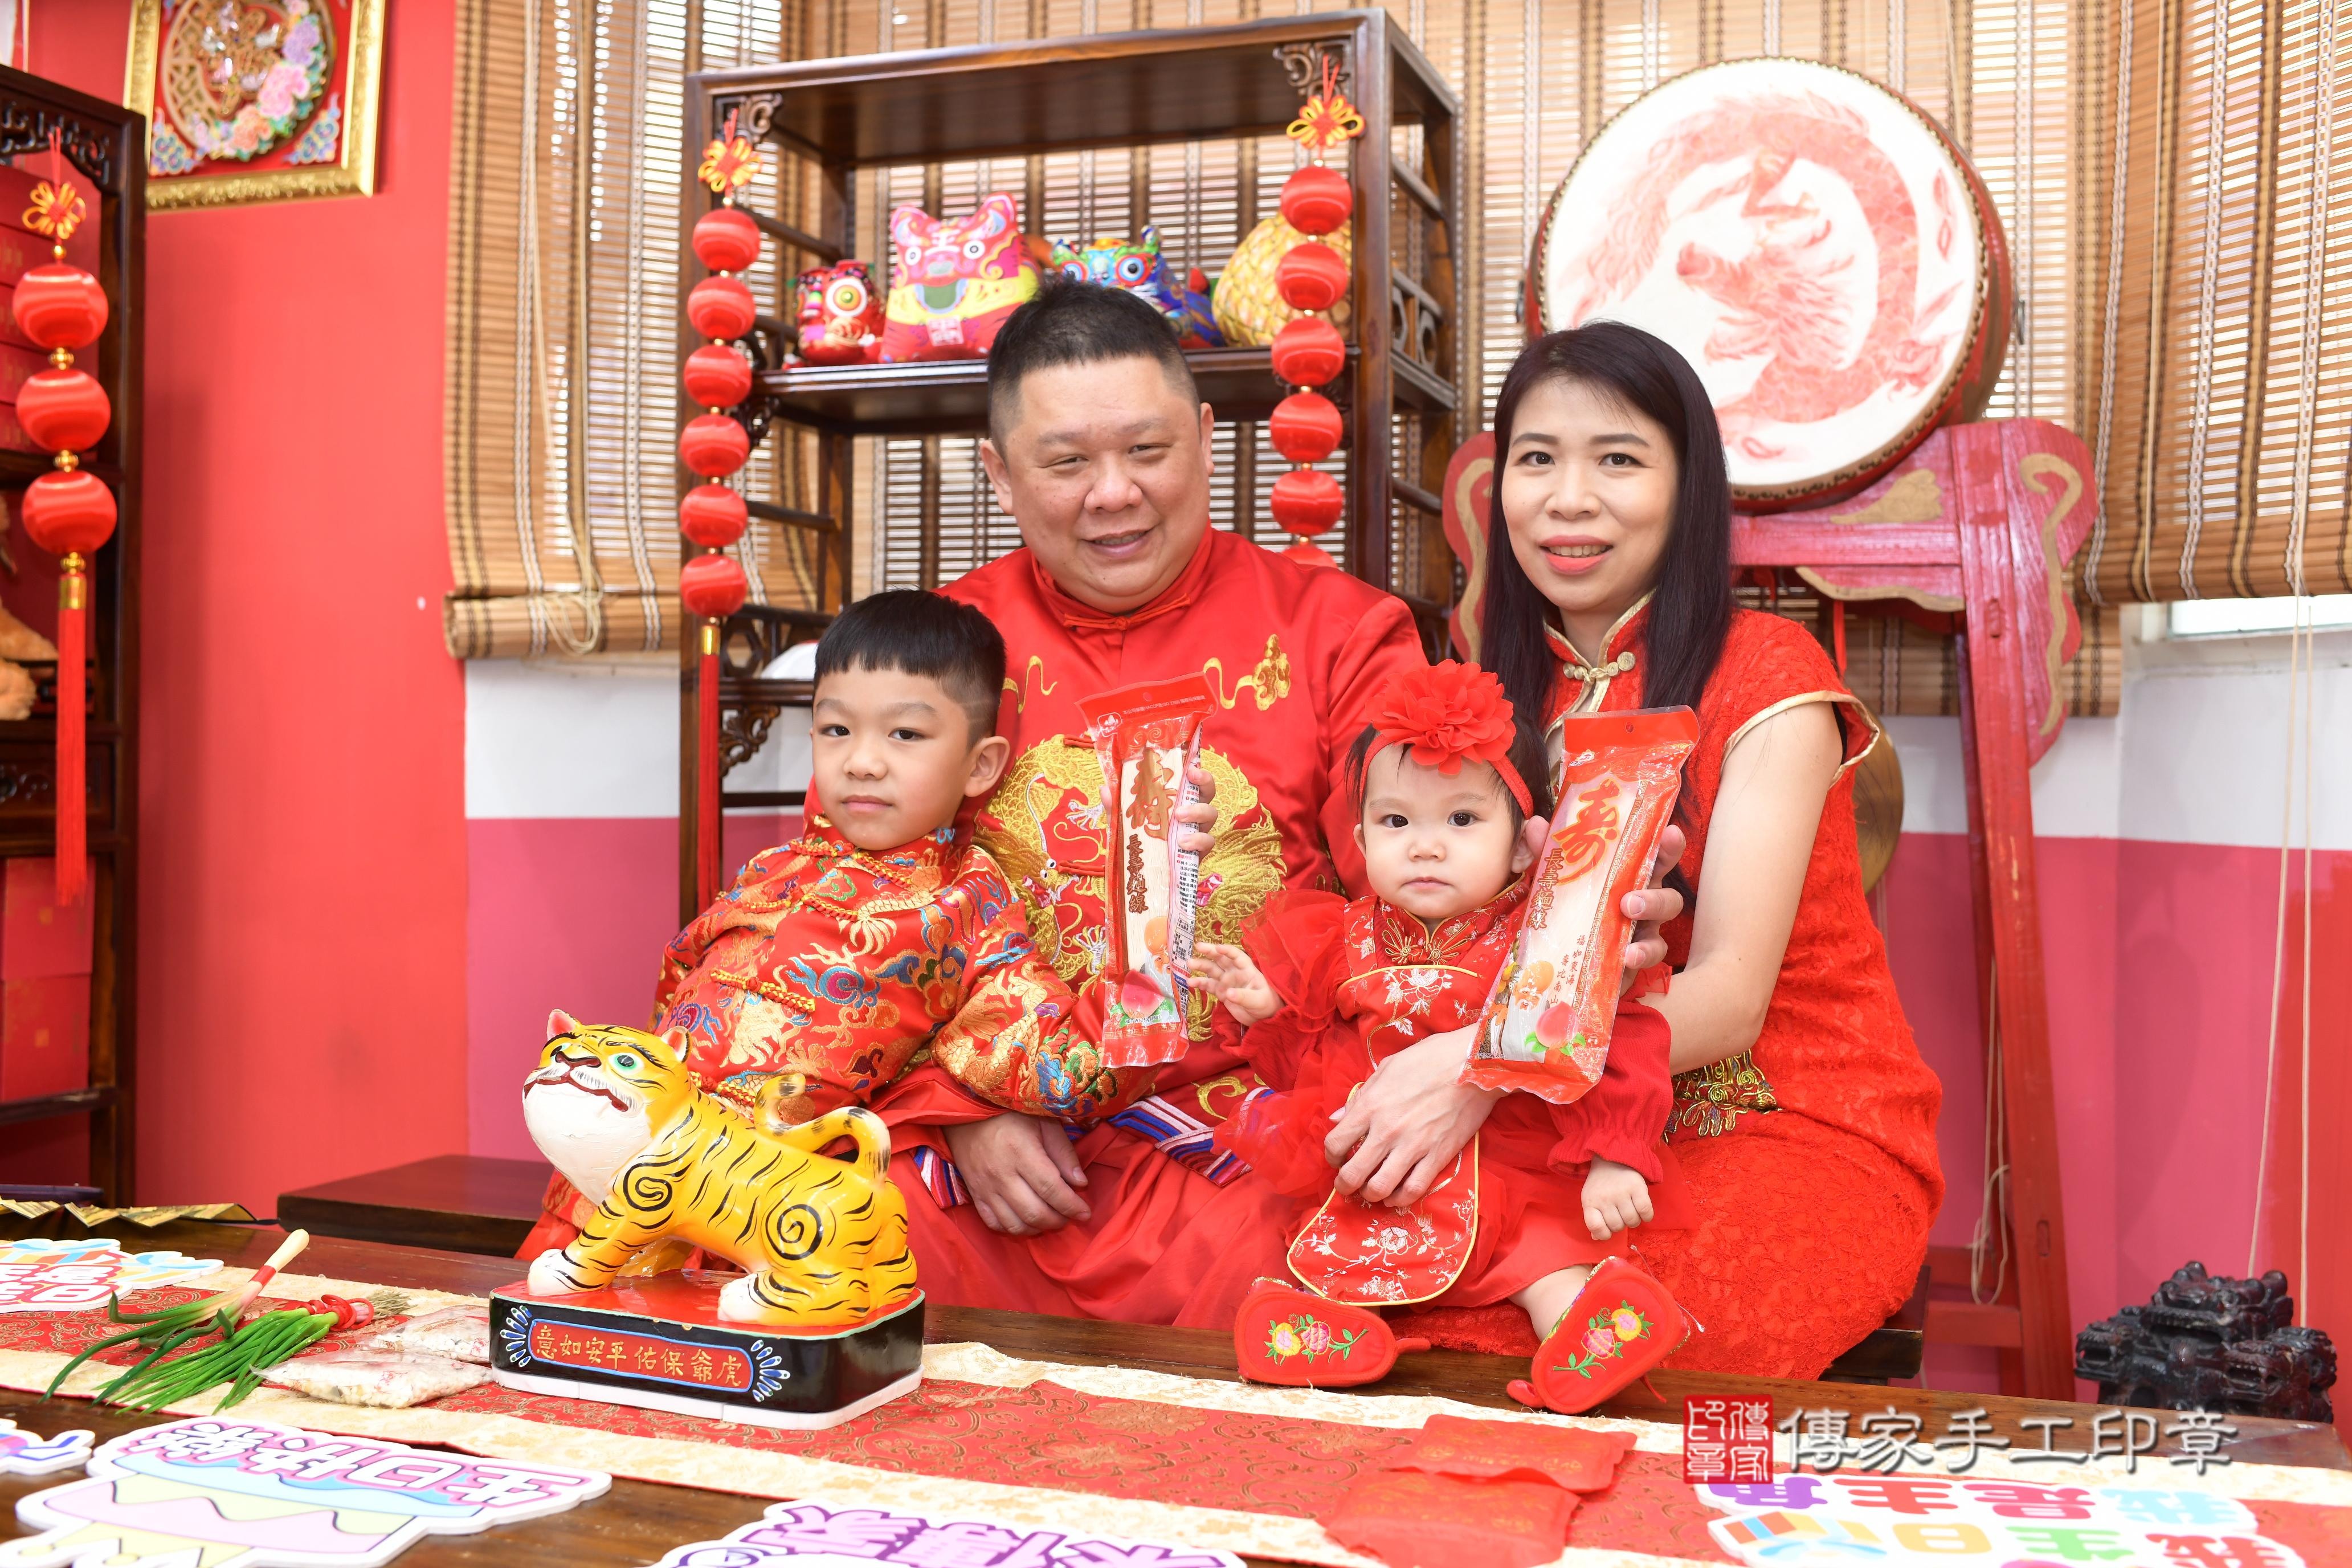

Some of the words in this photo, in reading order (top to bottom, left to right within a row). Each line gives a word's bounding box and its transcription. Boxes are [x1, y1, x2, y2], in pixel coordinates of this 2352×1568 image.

[1126, 834, 1149, 914] 長壽麵線
[1526, 848, 1564, 930] 長壽麵線
[1550, 954, 1569, 1004] 壽比南山
[1566, 935, 1586, 985] 福如東海
[126, 1422, 585, 1508] 生日快樂
